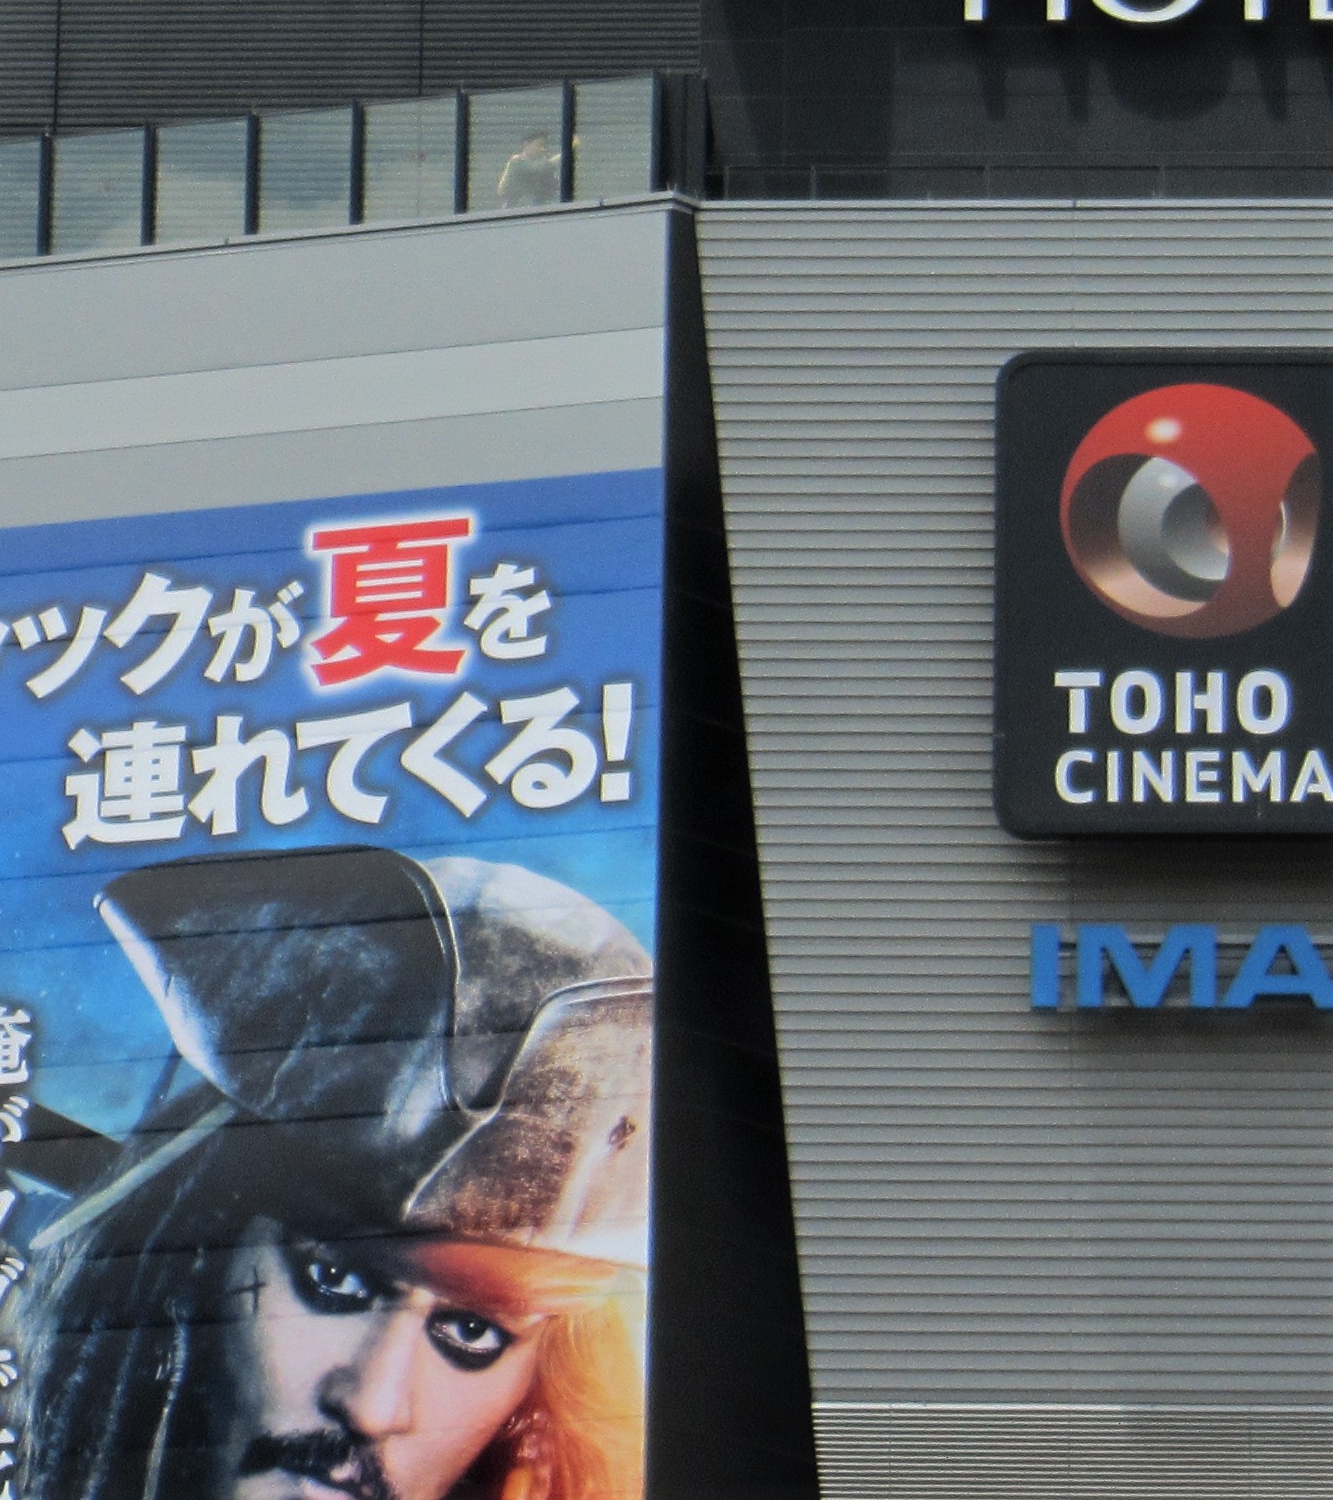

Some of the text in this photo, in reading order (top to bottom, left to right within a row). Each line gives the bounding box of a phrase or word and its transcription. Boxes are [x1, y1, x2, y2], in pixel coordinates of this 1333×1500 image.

[1054, 669, 1291, 736] TOHO
[63, 684, 632, 847] 連れてくる!
[1054, 750, 1333, 803] CINEMA
